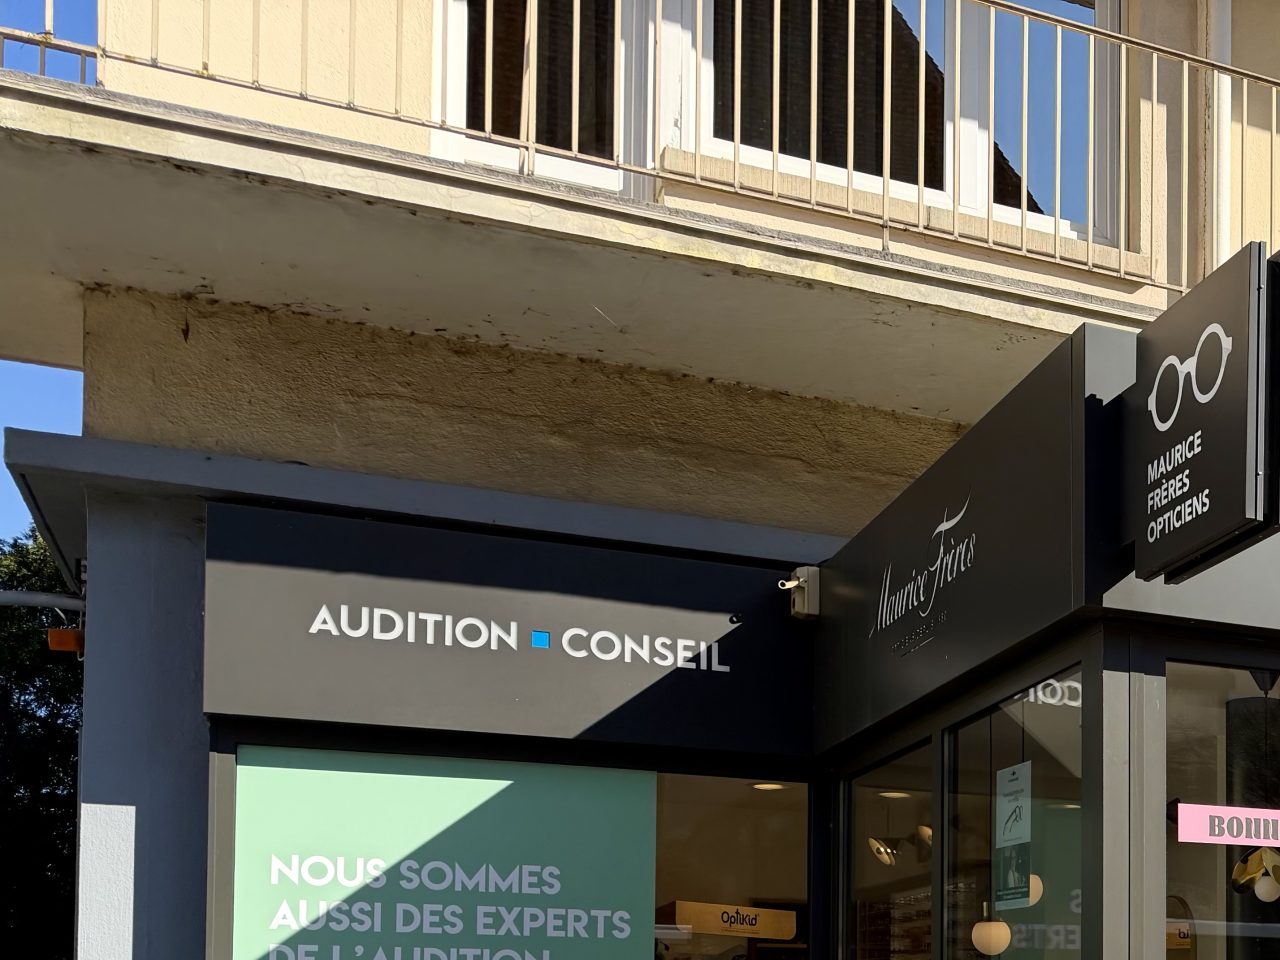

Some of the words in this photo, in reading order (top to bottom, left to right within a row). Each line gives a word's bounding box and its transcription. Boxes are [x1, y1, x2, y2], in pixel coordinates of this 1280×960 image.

[1147, 430, 1202, 485] MAURICE
[1147, 469, 1190, 514] FRÈRES
[1147, 489, 1210, 543] OPTICIENS
[869, 562, 928, 639] Maurice
[919, 492, 976, 617] Frères
[309, 604, 518, 650] AUDITION
[562, 627, 731, 672] CONSEIL
[269, 853, 387, 889] NOUS
[399, 859, 561, 895] SOMMES
[268, 899, 383, 933] AUSSI
[395, 903, 464, 935] DES
[476, 905, 631, 939] EXPERTS
